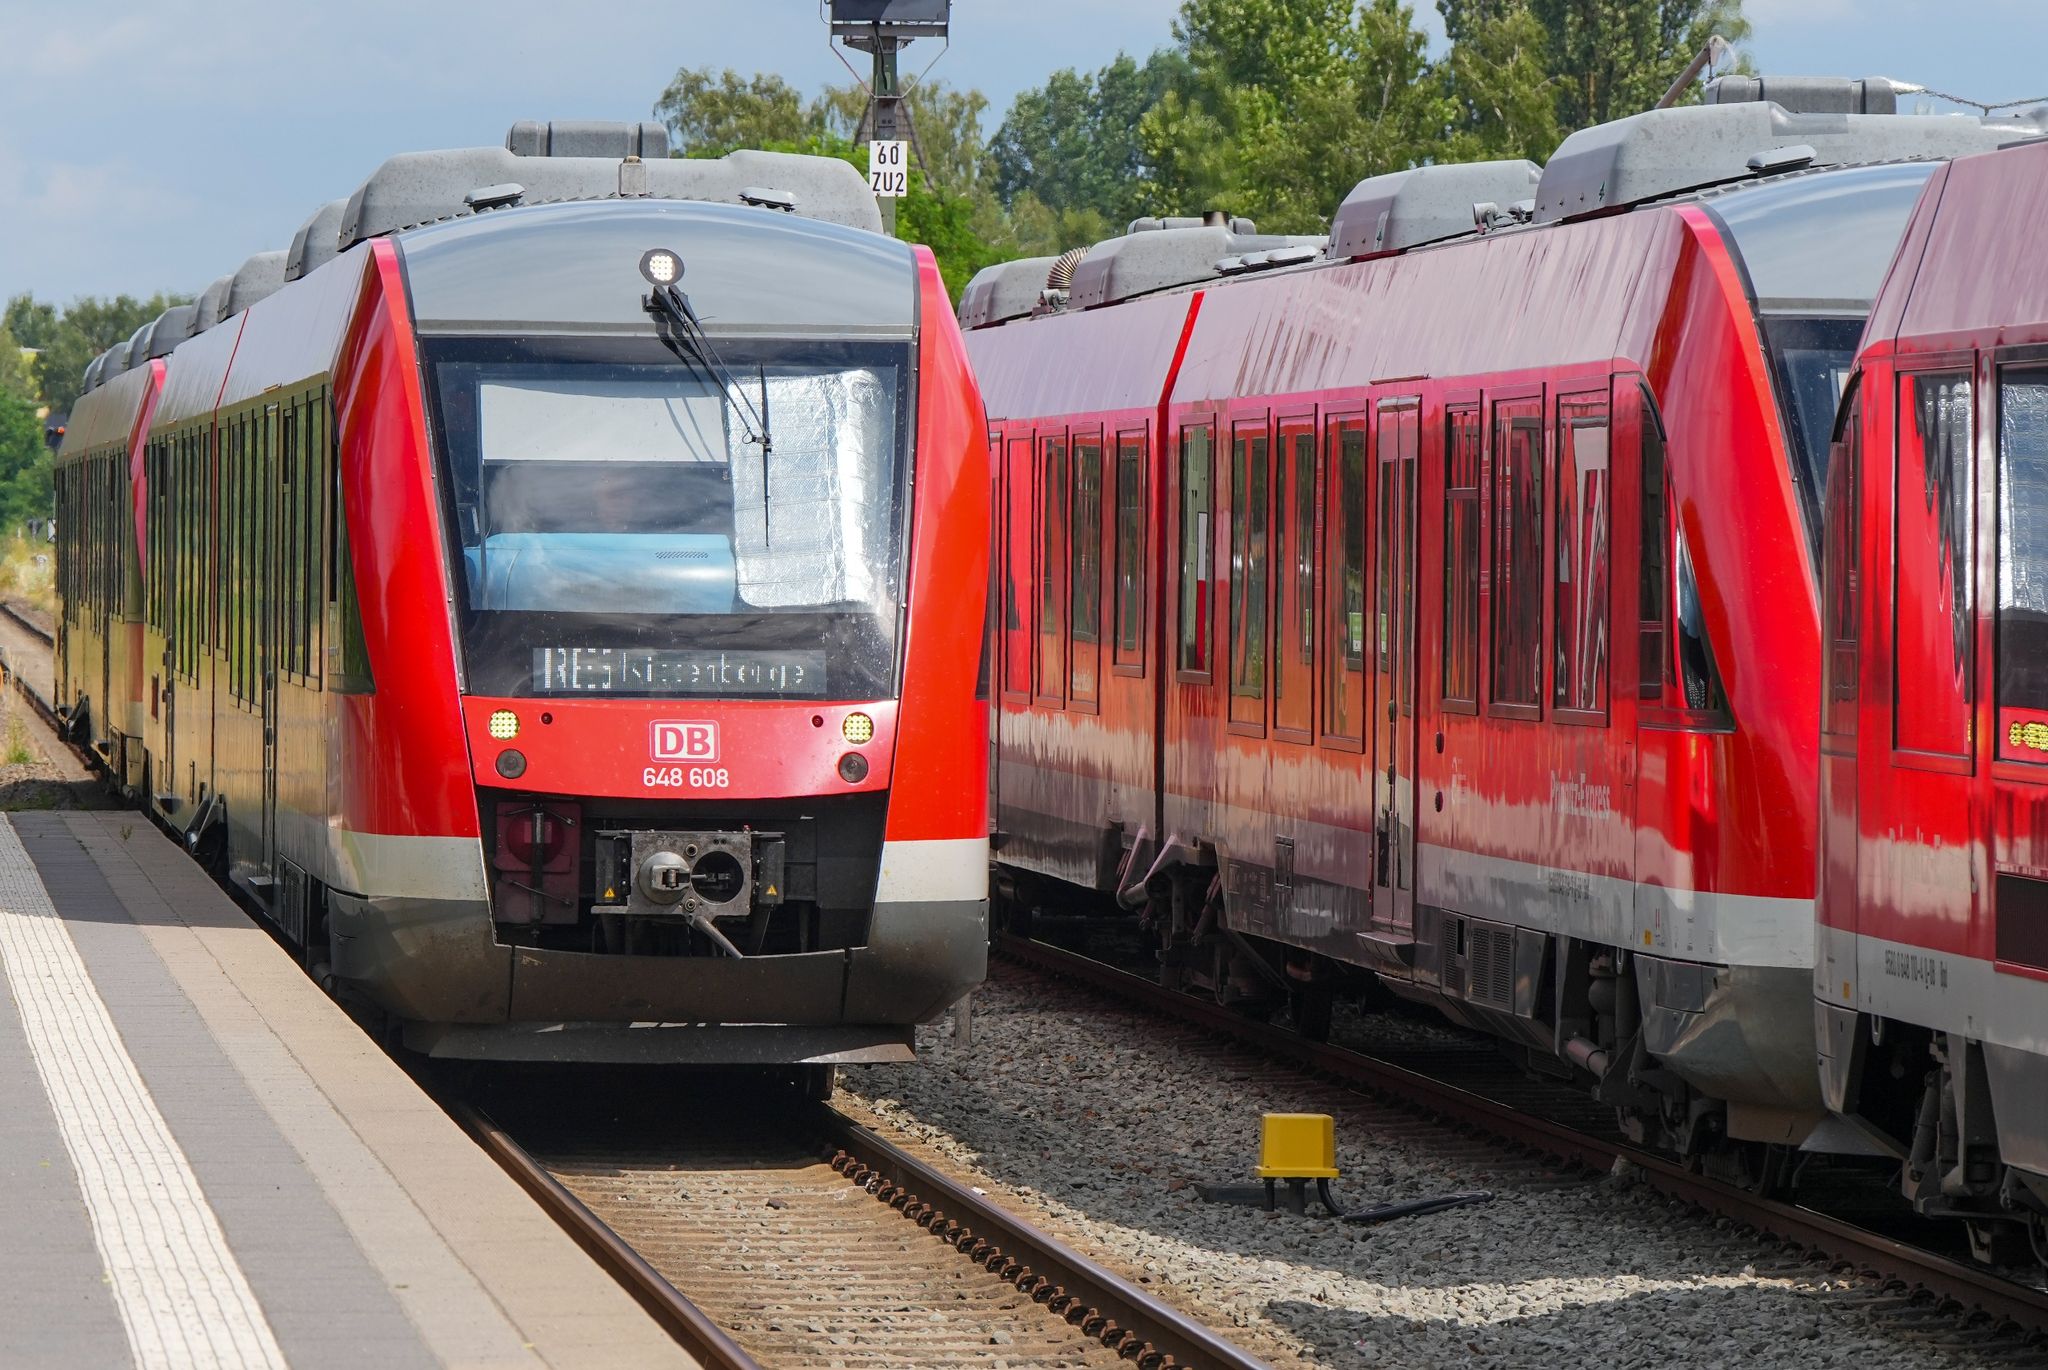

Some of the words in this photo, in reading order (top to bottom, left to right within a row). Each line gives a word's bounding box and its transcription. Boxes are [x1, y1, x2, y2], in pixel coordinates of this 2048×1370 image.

[878, 145, 899, 165] 60
[872, 172, 904, 192] ZU2
[657, 725, 712, 757] DB
[643, 767, 683, 788] 648
[689, 767, 729, 788] 608
